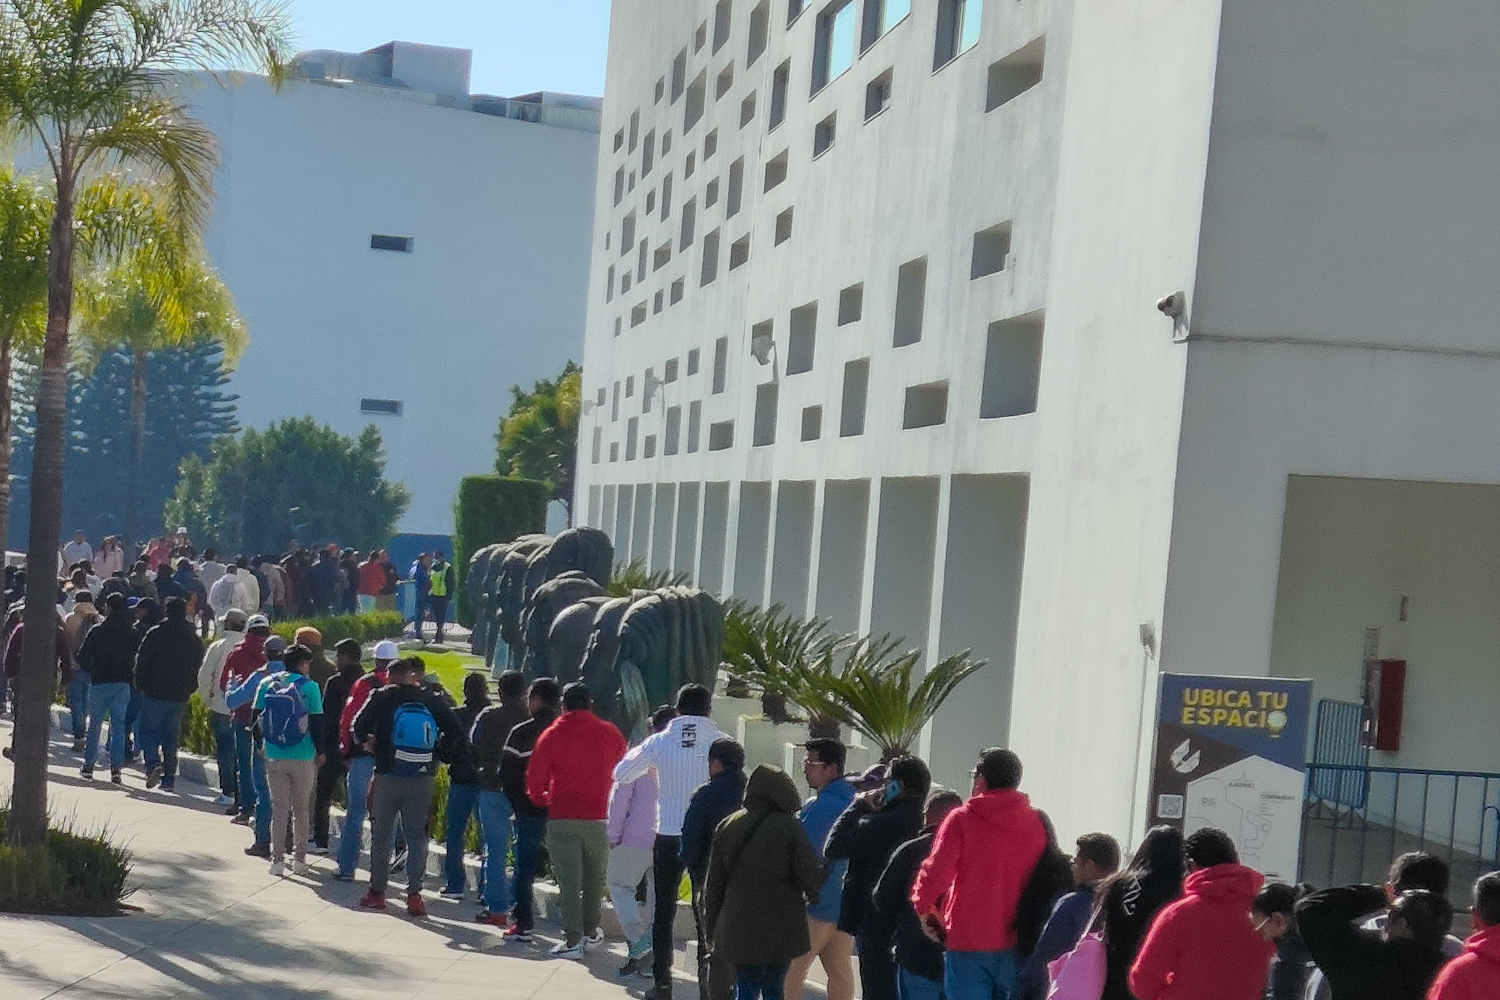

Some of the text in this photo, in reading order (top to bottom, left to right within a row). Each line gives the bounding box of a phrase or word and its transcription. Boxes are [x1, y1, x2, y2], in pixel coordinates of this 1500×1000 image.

[1184, 687, 1288, 710] UBICA TU
[681, 724, 697, 748] NEW
